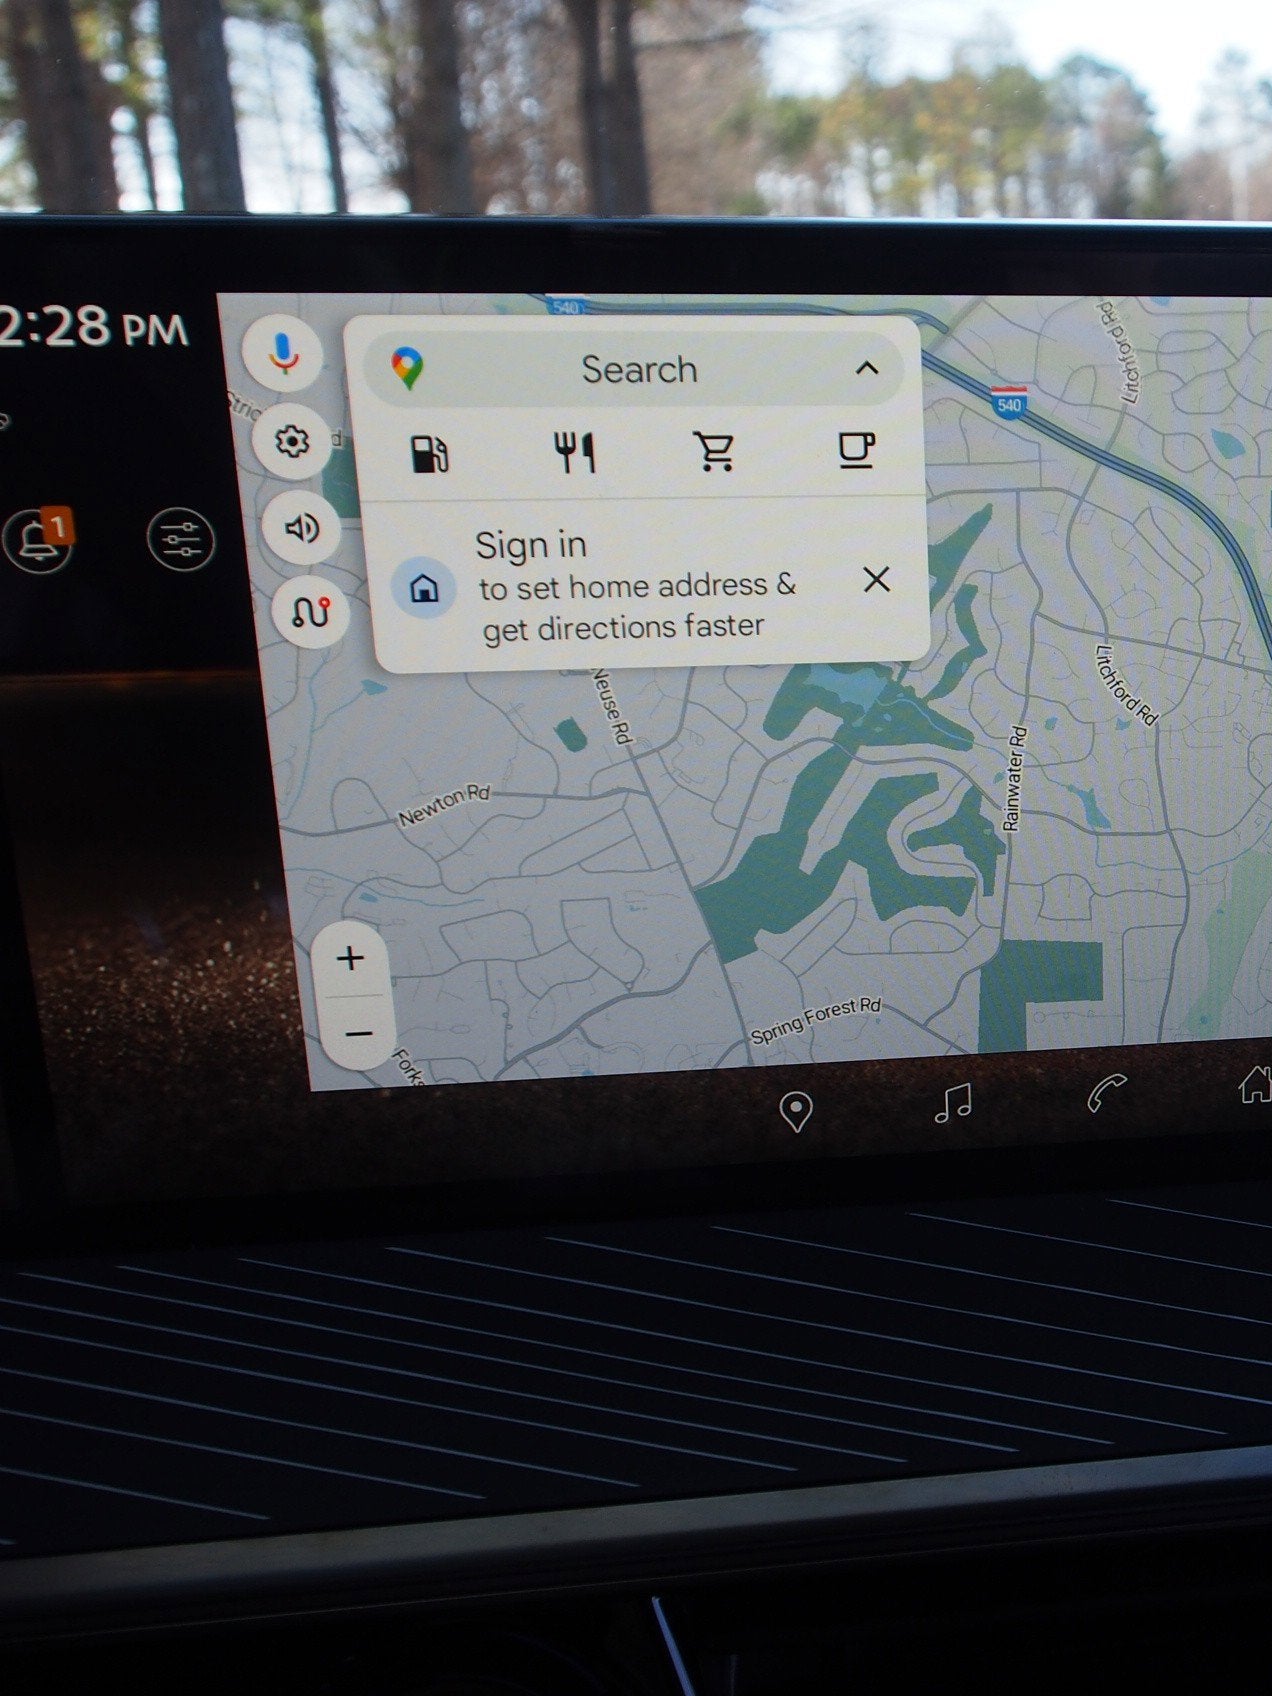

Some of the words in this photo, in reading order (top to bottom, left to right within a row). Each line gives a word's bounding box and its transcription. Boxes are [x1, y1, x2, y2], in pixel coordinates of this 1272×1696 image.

[123, 314, 190, 346] PM
[1096, 302, 1118, 325] Rd
[581, 354, 698, 383] Search
[1107, 325, 1139, 404] Litchford
[998, 398, 1022, 411] 540
[51, 516, 65, 538] 1
[476, 529, 549, 566] Sign
[559, 528, 587, 557] in
[478, 578, 508, 601] to
[516, 577, 561, 600] set
[569, 574, 650, 599] home
[658, 571, 769, 597] address
[776, 571, 797, 596] &
[483, 620, 529, 649] get
[537, 615, 677, 641] directions
[684, 612, 766, 638] faster
[1096, 645, 1141, 711] Litchford
[1135, 704, 1160, 727] Rd
[591, 668, 620, 721] Neuse
[611, 722, 634, 745] Rd
[1009, 725, 1028, 748] Rd
[398, 790, 466, 828] Newton
[466, 784, 491, 801] Rd
[1003, 750, 1023, 832] Rainwater
[751, 1017, 804, 1045] Spring
[804, 999, 856, 1025] Forest
[860, 997, 882, 1013] Rd
